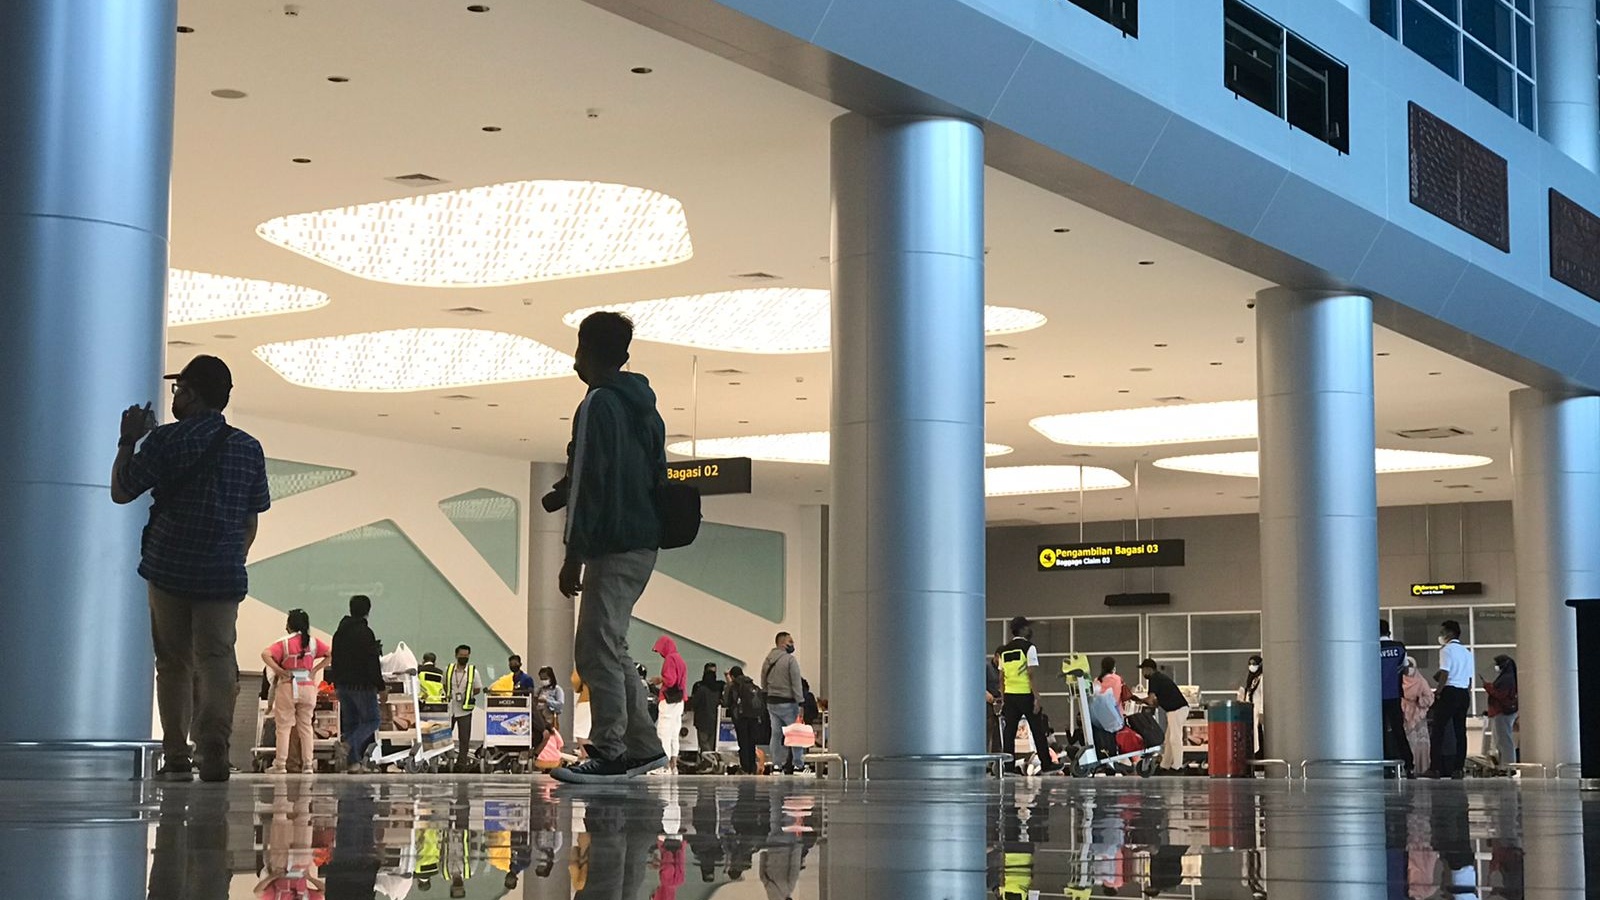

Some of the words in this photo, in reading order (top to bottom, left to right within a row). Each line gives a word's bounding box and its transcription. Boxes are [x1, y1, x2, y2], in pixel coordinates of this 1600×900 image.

[667, 466, 701, 481] Bagasi
[704, 465, 719, 477] 02
[1056, 547, 1112, 558] Pengambilan
[1115, 545, 1144, 556] Bagasi
[1147, 544, 1158, 553] 03
